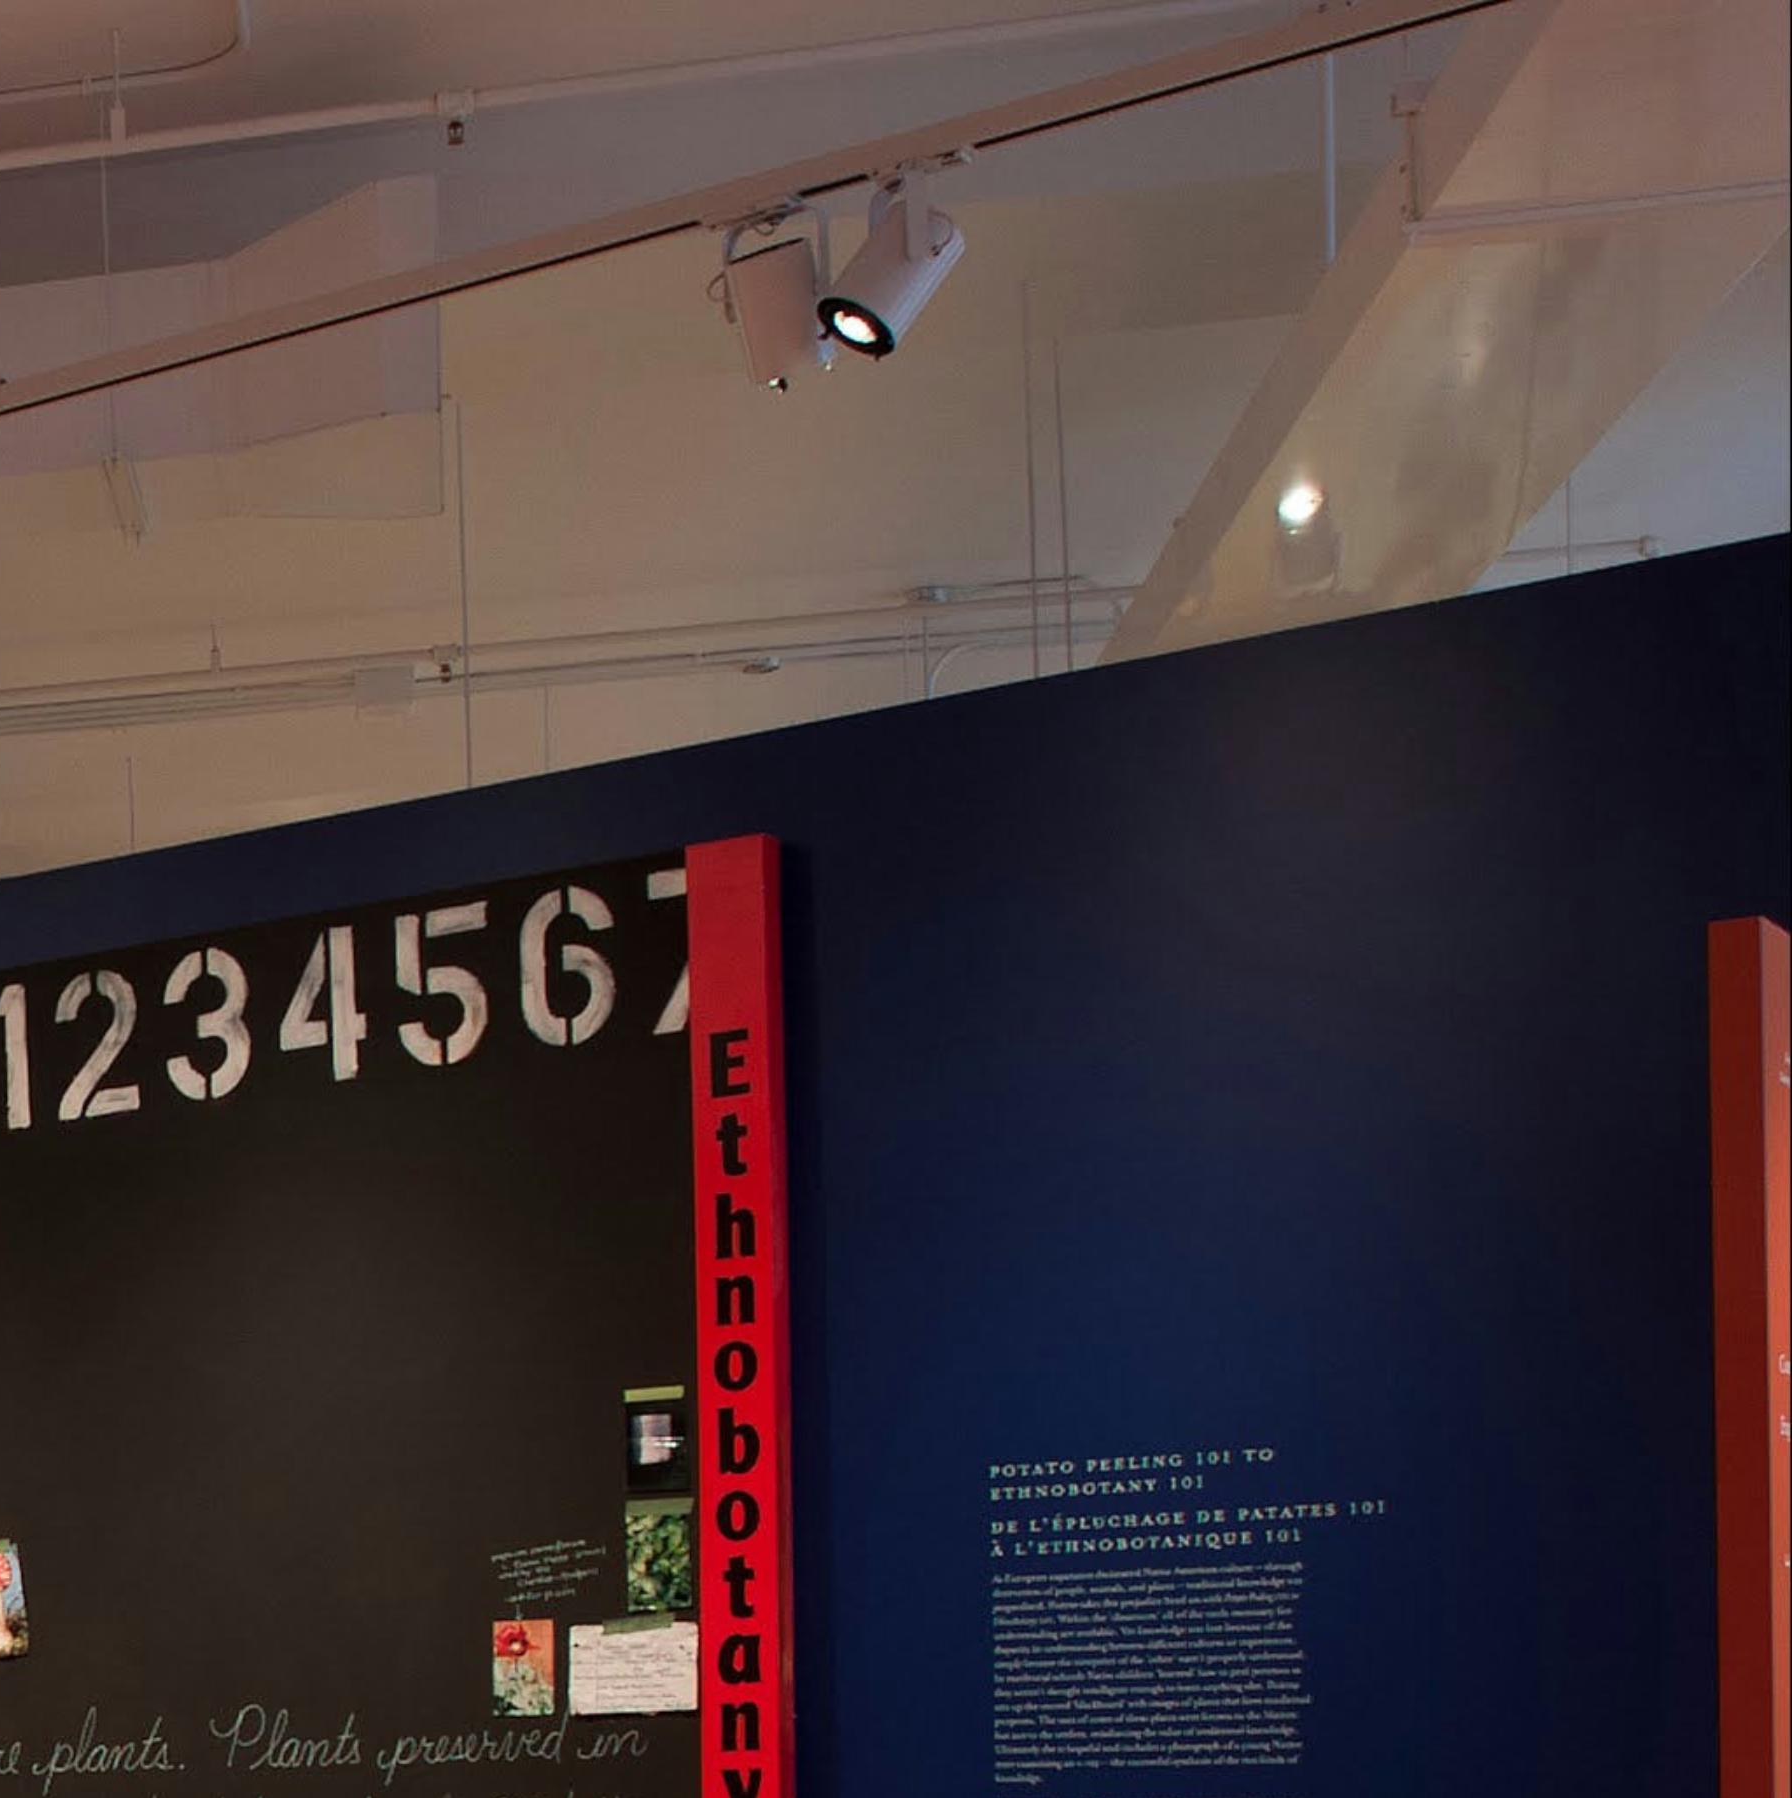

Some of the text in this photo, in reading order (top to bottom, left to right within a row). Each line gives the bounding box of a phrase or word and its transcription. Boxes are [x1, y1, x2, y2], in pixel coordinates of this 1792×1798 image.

[989, 1447, 1274, 1479] POTATO PEELING 101 TO
[990, 1475, 1204, 1501] ETHNOBOTANY 101
[991, 1520, 1017, 1535] DE
[1197, 1508, 1225, 1523] DE
[1238, 1502, 1337, 1521] PATATES
[1349, 1500, 1385, 1516] 101
[1265, 1528, 1303, 1544] 101
[209, 1703, 362, 1771] Plants
[376, 1711, 569, 1788] preserved
[577, 1727, 650, 1761] in
